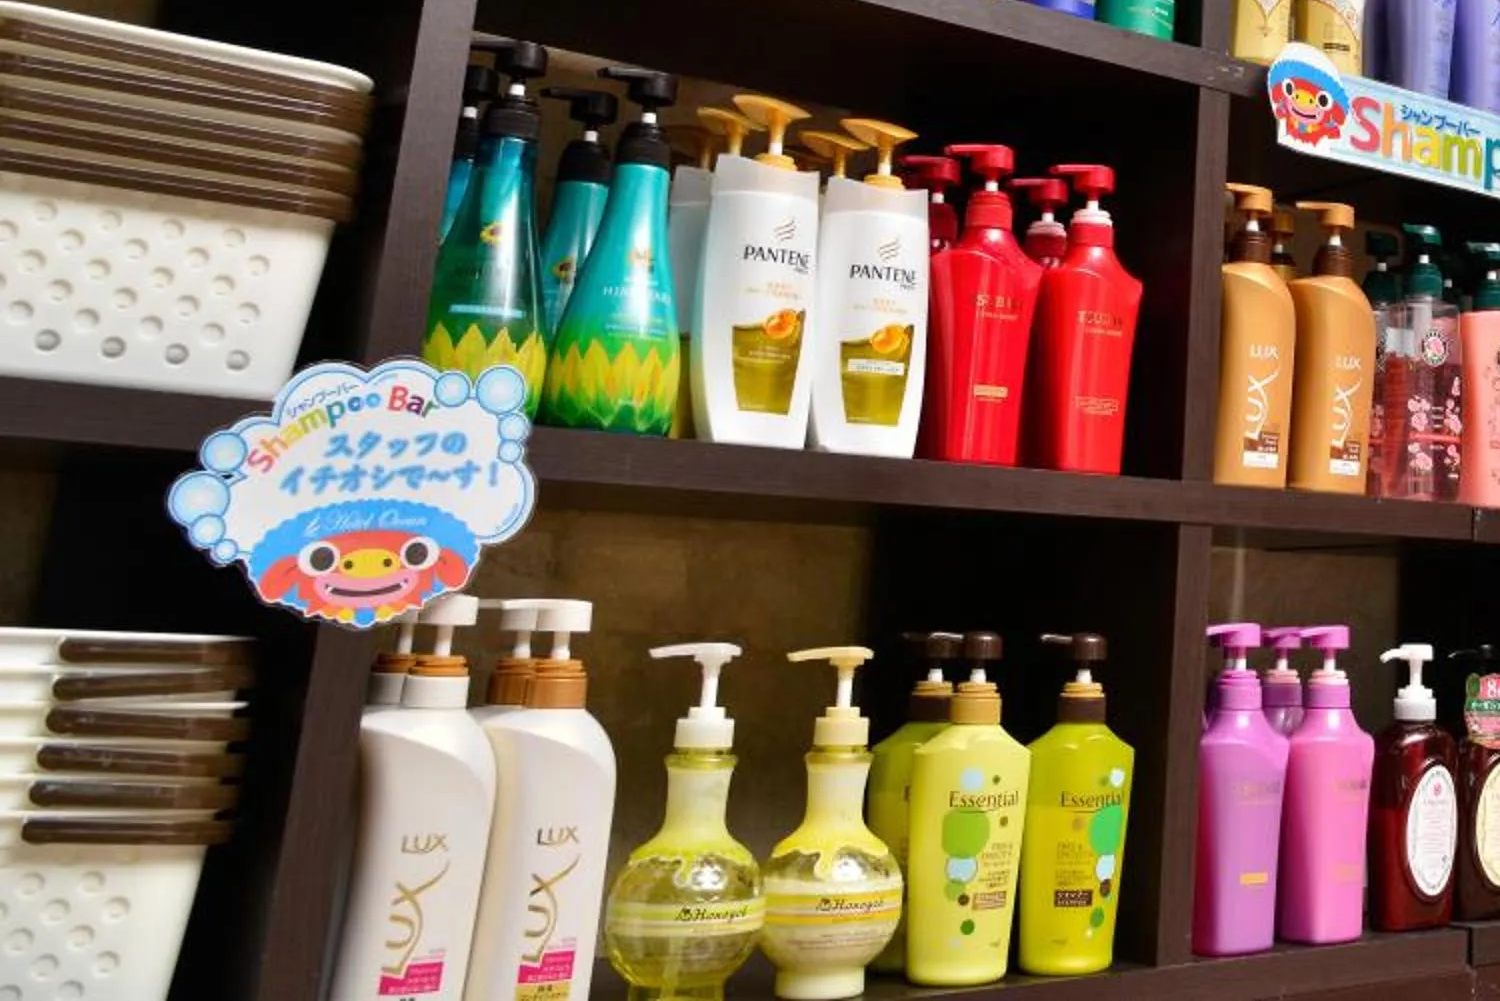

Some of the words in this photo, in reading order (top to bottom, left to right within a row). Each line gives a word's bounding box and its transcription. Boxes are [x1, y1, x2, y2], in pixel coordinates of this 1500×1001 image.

[1400, 103, 1481, 137] シャンプーバー
[743, 245, 811, 269] PANTENE
[850, 263, 917, 285] PANTENE
[1251, 344, 1279, 360] LUX
[247, 392, 381, 474] Shampoo
[388, 385, 439, 418] Bar
[323, 430, 467, 459] スタッフの
[948, 790, 1019, 809] Essential
[1060, 790, 1124, 809] Essential
[400, 834, 450, 855] LUX
[537, 826, 580, 847] LUX
